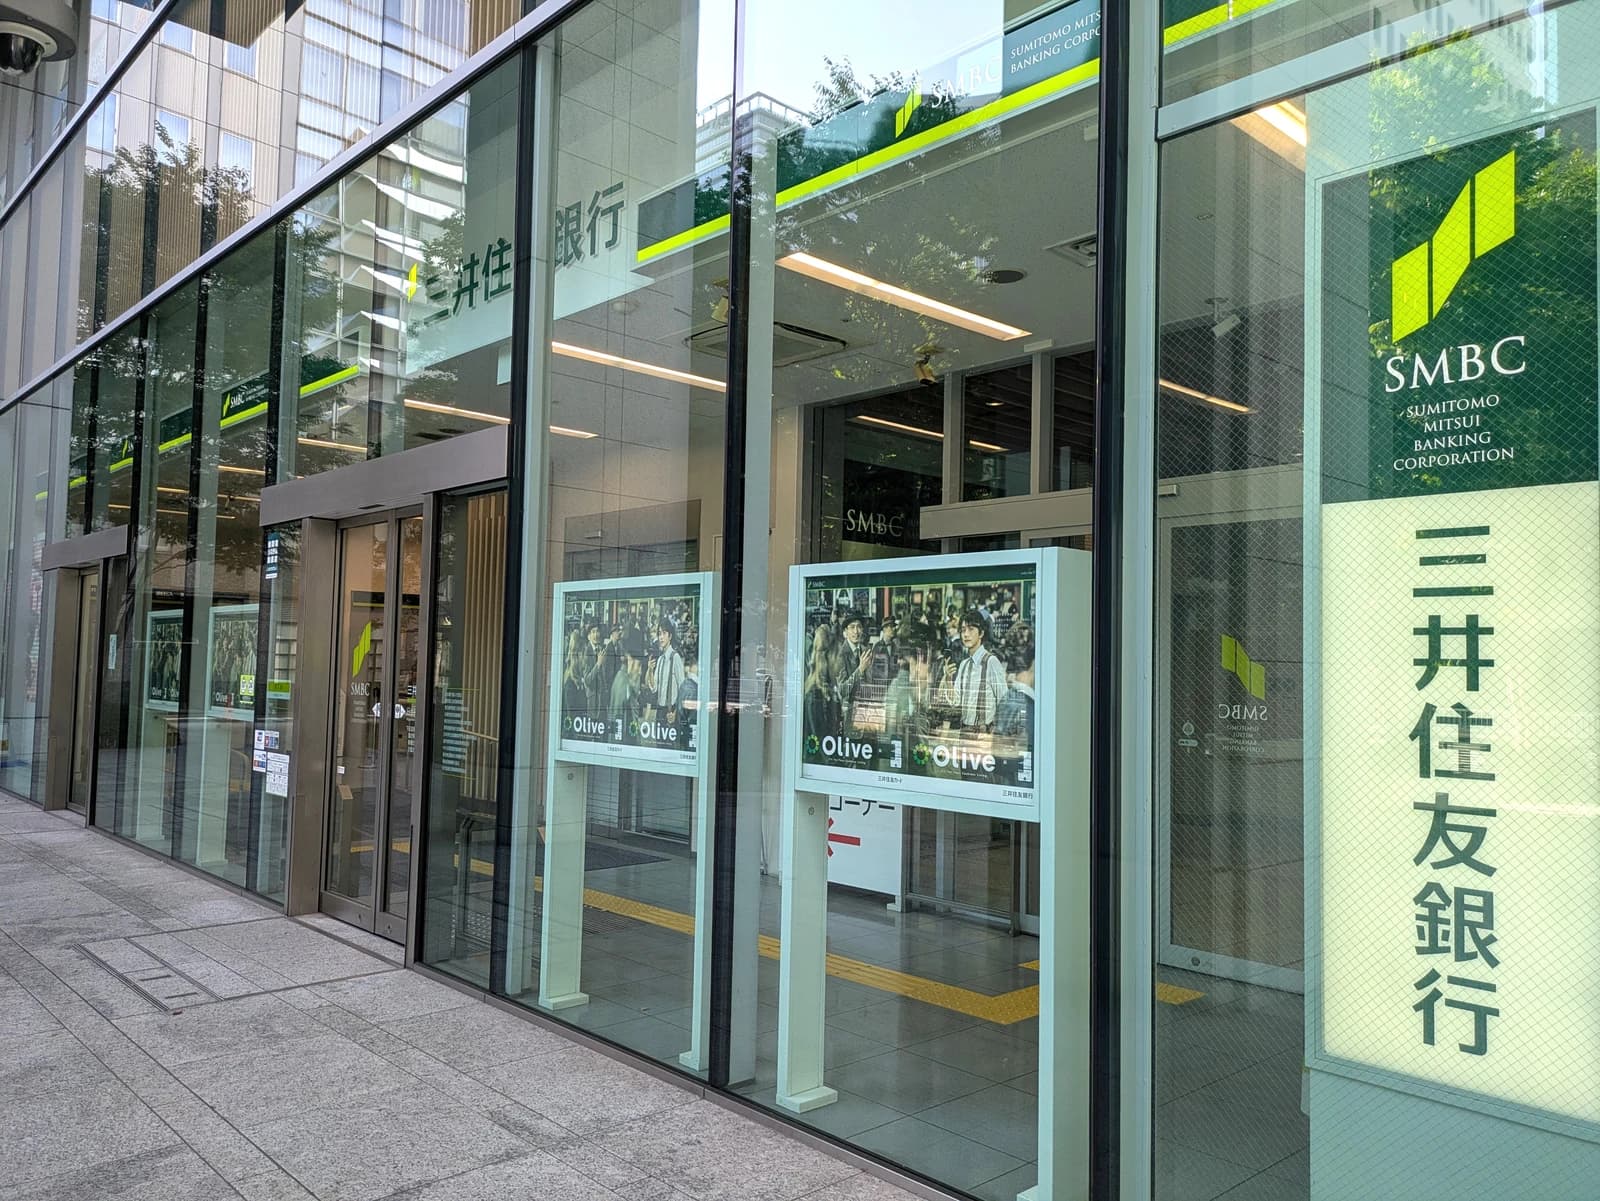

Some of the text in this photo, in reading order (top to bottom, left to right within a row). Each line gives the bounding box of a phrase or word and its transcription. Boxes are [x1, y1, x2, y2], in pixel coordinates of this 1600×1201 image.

[1010, 24, 1071, 59] SUMITOMO
[1010, 44, 1061, 74] BANKING
[931, 56, 1000, 108] SMBC
[1385, 335, 1526, 393] SMBC
[1406, 394, 1500, 418] SUMITOMO
[1424, 414, 1480, 433] MITSUI
[1414, 431, 1491, 451] BANKING
[1393, 447, 1514, 471] CORPORATION
[846, 508, 903, 537] SMBC
[350, 682, 370, 697] SMBC
[573, 716, 605, 734] Olive
[640, 721, 677, 741] Olive
[822, 735, 873, 760] Olive
[933, 744, 996, 772] Olive
[1408, 525, 1500, 1056] 三井住友銀行
